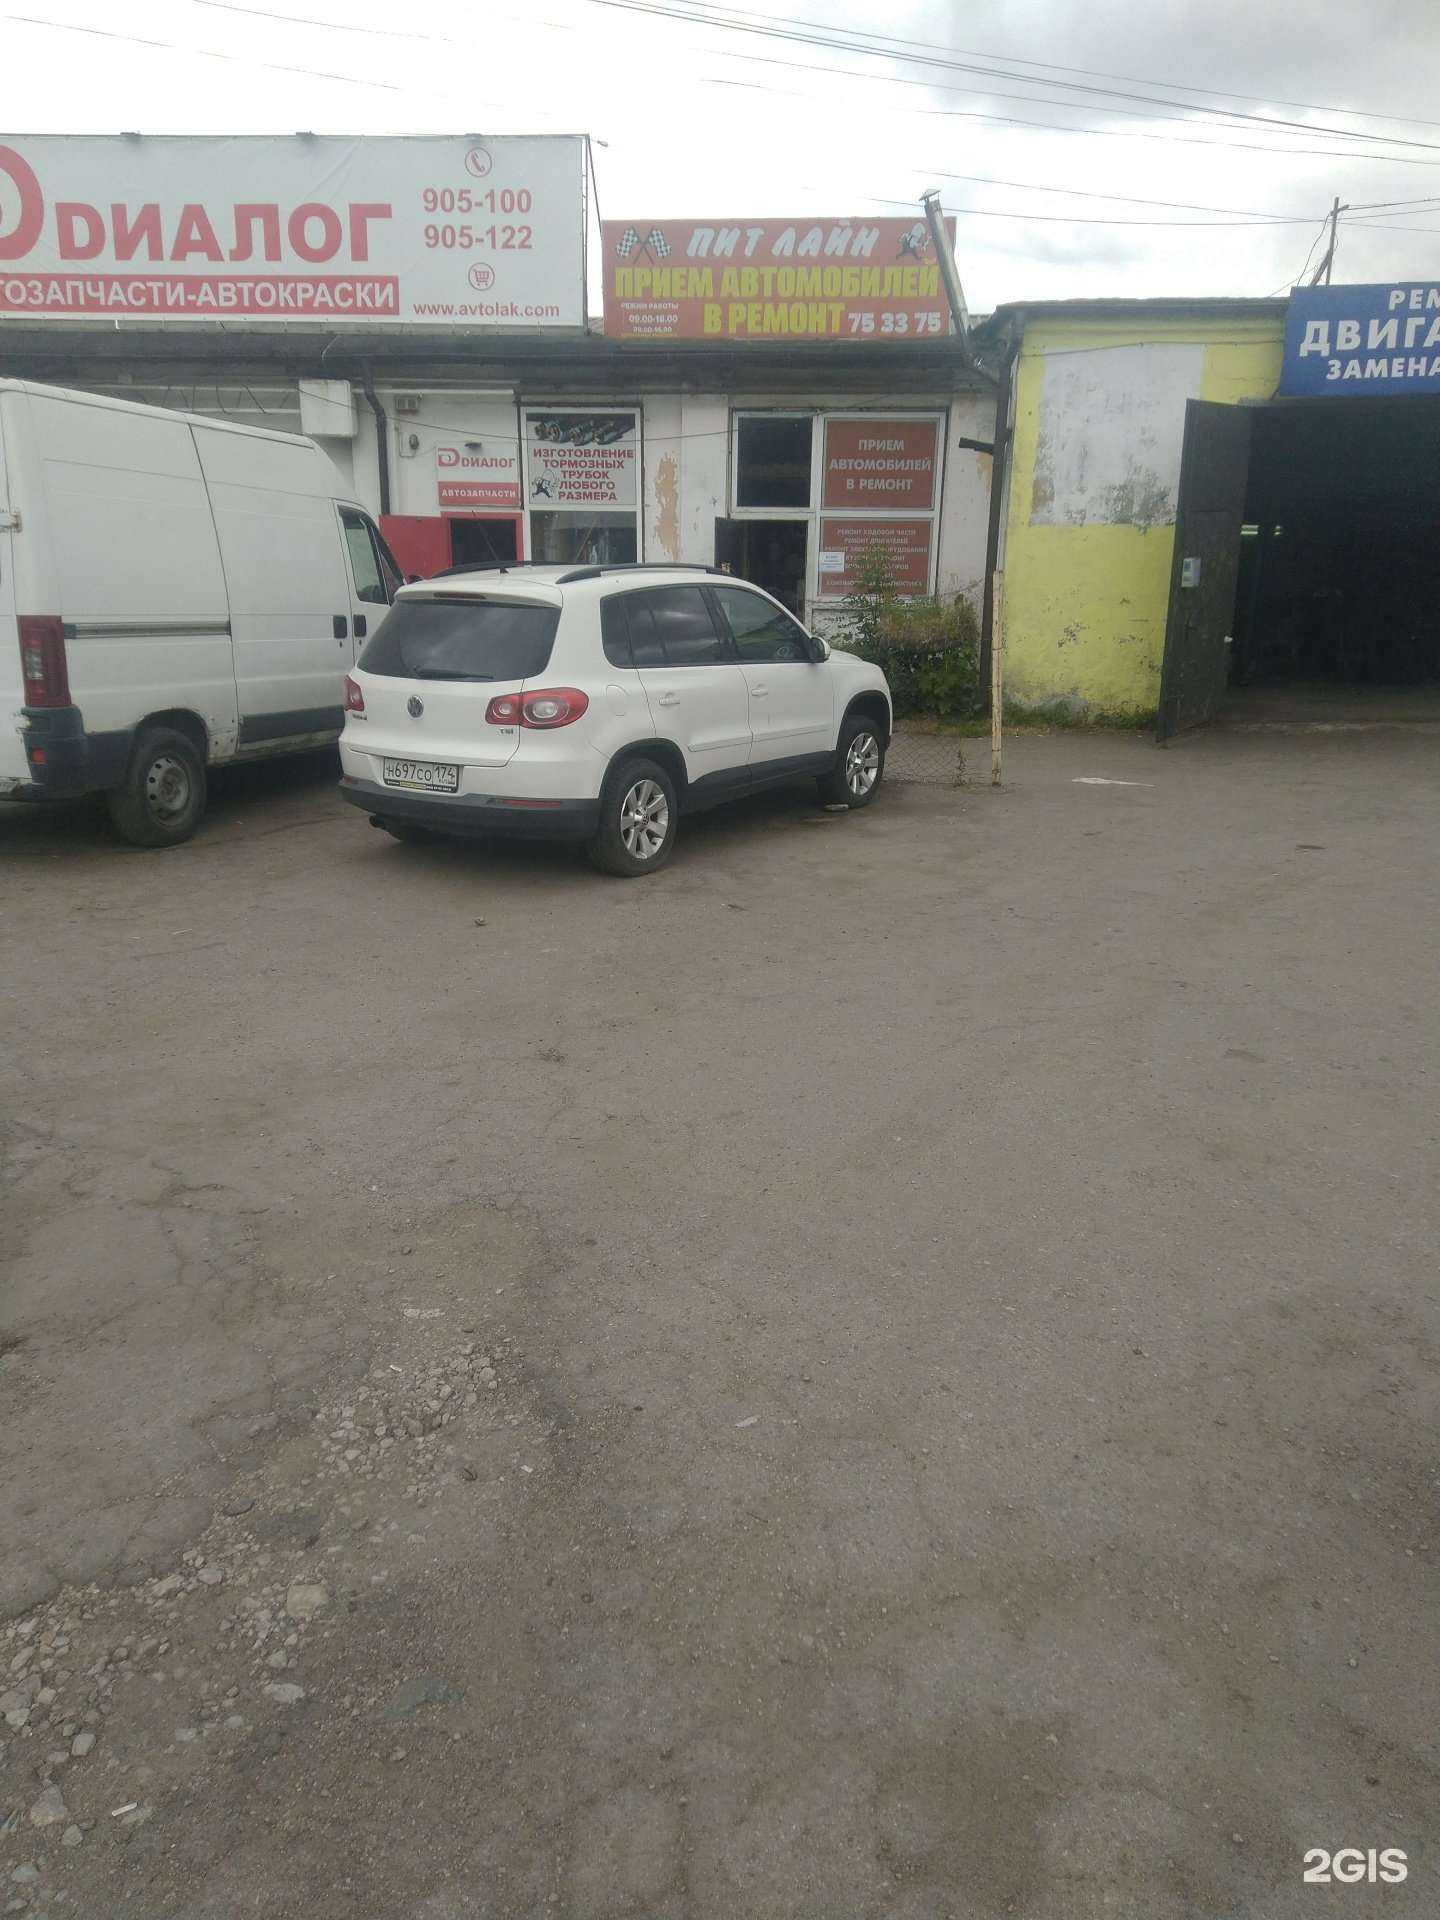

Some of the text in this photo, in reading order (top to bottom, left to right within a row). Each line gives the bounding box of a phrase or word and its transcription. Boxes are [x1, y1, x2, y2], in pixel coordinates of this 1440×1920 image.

[422, 187, 533, 214] 905-100
[422, 224, 533, 251] 905-122
[686, 220, 880, 257] ПИТ ЛАЙН
[615, 258, 940, 300] ПРИЕМ АВТОМОБИЛЕЙ
[0, 279, 395, 309] ОЗАПЧАСТИ-АВТОКРАСКИ
[413, 300, 560, 318] www.avtolak.com
[704, 302, 846, 334] В РЕМОНТ
[848, 312, 941, 333] 75 33 75
[1325, 356, 1440, 380] ЗАМЕНА
[533, 448, 634, 458] ИЗГОТОВЛЕНИЕ
[858, 439, 905, 452] ПРИЕМ
[543, 459, 625, 469] ТОРМОЗНЫХ
[829, 457, 932, 471] АВТОМОБИЛЕЙ
[560, 470, 610, 480] ТРУБОК
[559, 480, 616, 490] ЛЮБОГО
[846, 479, 913, 490] В РЕМОНТ
[441, 488, 516, 498] АВТОЗАПЧАСТИ
[558, 491, 618, 501] РАЗМЕРА
